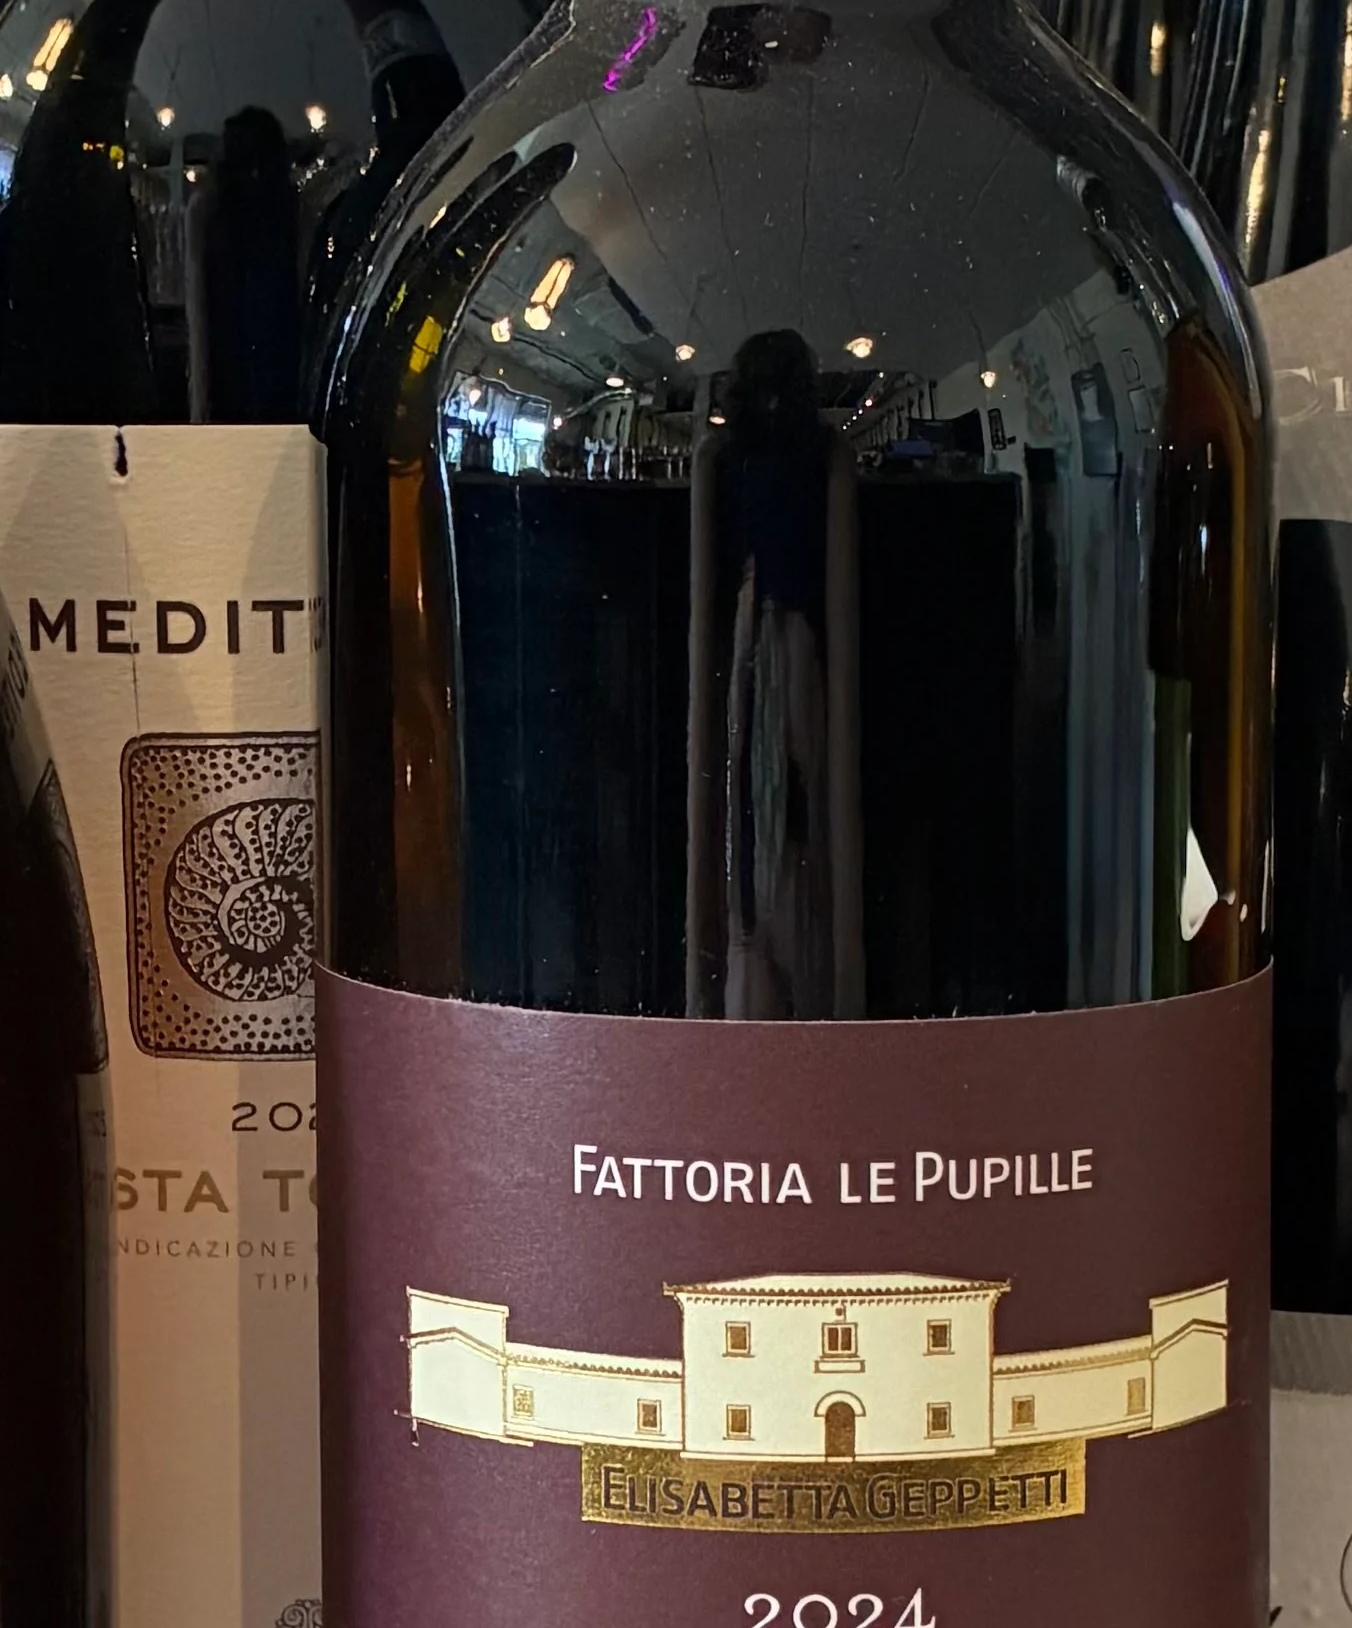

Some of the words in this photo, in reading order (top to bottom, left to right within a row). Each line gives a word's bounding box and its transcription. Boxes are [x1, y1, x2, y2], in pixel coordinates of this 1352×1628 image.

[573, 1144, 812, 1204] FATTORIA
[840, 1161, 896, 1204] LE
[915, 1148, 1093, 1203] PUPILLE
[601, 1463, 855, 1522] ELISABETTA
[865, 1469, 1069, 1521] GEPPETTI
